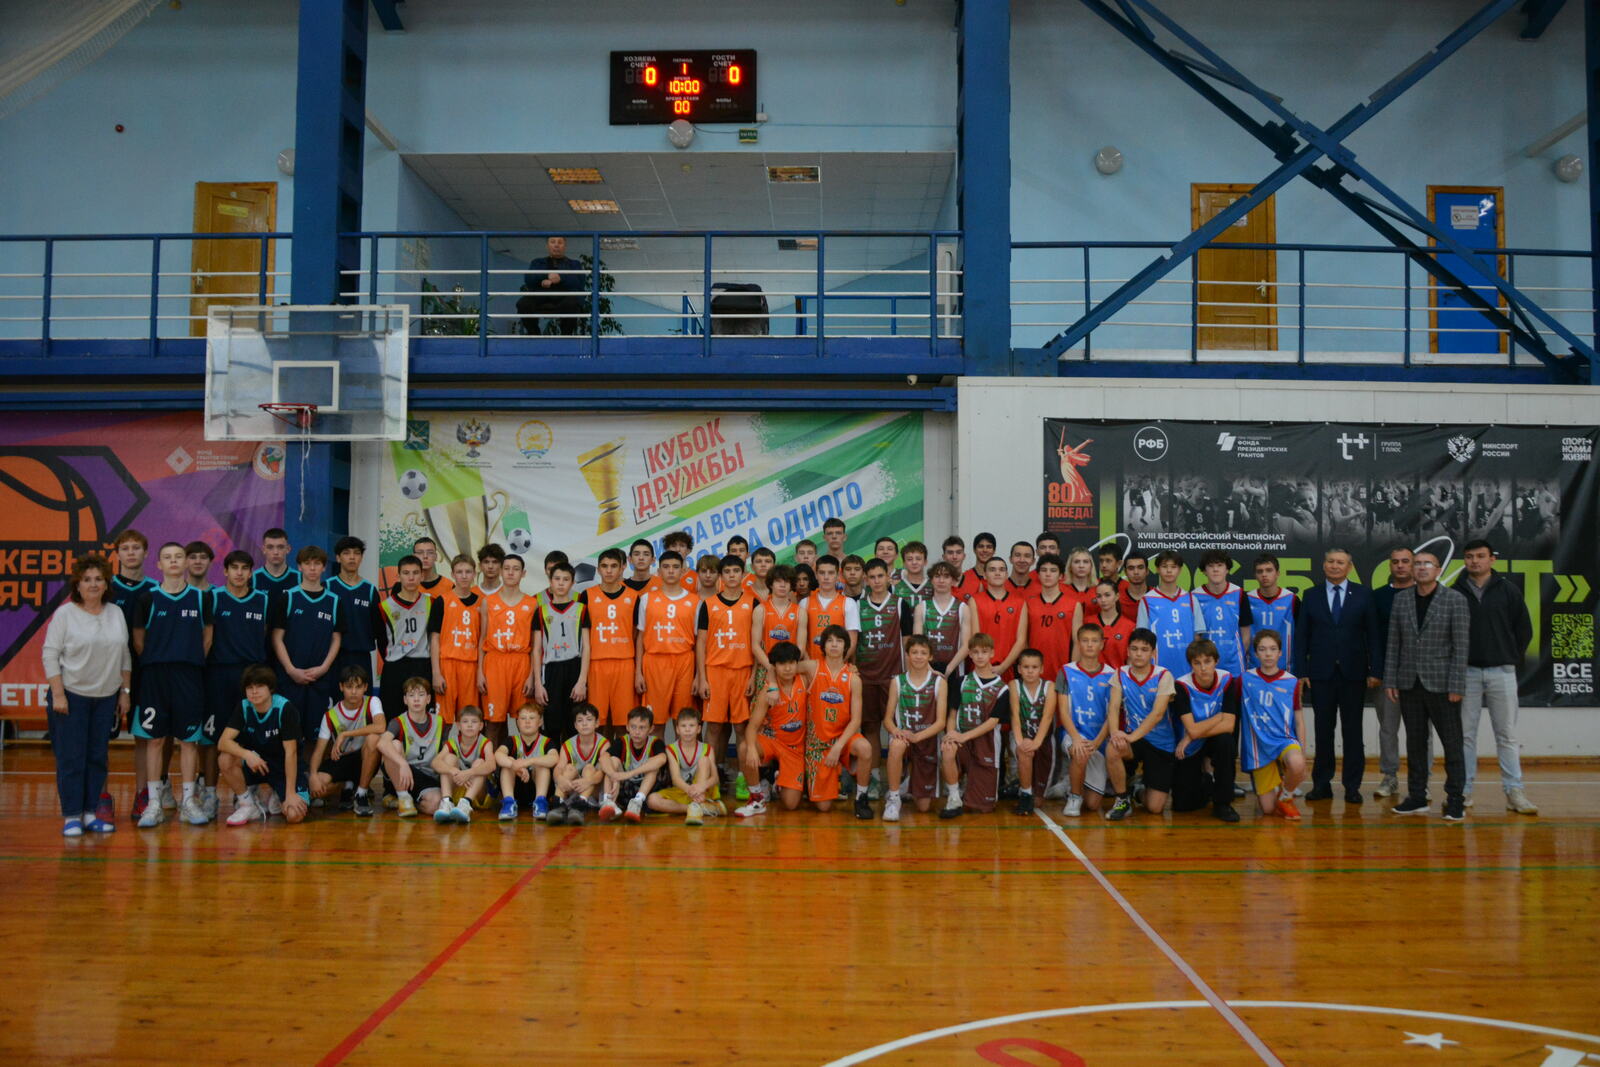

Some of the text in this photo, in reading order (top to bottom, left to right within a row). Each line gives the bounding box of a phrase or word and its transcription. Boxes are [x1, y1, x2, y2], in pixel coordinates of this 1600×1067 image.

[682, 62, 687, 75] 1
[729, 66, 740, 84] 0
[645, 67, 656, 86] 0
[670, 80, 700, 94] 10:00
[674, 100, 690, 114] 00
[648, 418, 725, 474] КУБОК
[1138, 439, 1164, 448] РФБ
[637, 442, 744, 518] ДРУЖБЫ
[1048, 482, 1072, 503] 80
[710, 498, 758, 536] ВСЕХ
[768, 482, 862, 546] ОДНОГО
[1048, 507, 1093, 520] ПОБЕДА!
[1158, 532, 1232, 540] ВСЕРОССИЙСКИЙ
[1138, 541, 1187, 549] ШКОЛЬНОЙ
[1189, 542, 1262, 550] БАСКЕТБОЛЬНОЙ
[462, 610, 471, 625] 8
[506, 610, 515, 625] 3
[607, 604, 616, 619] 6
[667, 604, 676, 618] 9
[727, 610, 734, 625] 1
[1172, 609, 1179, 623] 9
[1216, 606, 1223, 621] 3
[405, 618, 417, 634] 10
[875, 614, 882, 627] 6
[937, 616, 943, 629] 7
[1040, 615, 1053, 627] 10
[1261, 612, 1274, 626] 11
[561, 622, 566, 637] 1
[1553, 663, 1592, 678] ВСЕ
[976, 688, 982, 701] 3
[1088, 686, 1094, 701] 5
[1554, 684, 1594, 695] ЗДЕСЬ
[914, 694, 920, 707] 1
[1259, 690, 1274, 706] 10
[143, 707, 156, 730] 2
[1030, 708, 1038, 719] 2
[204, 714, 216, 736] 4
